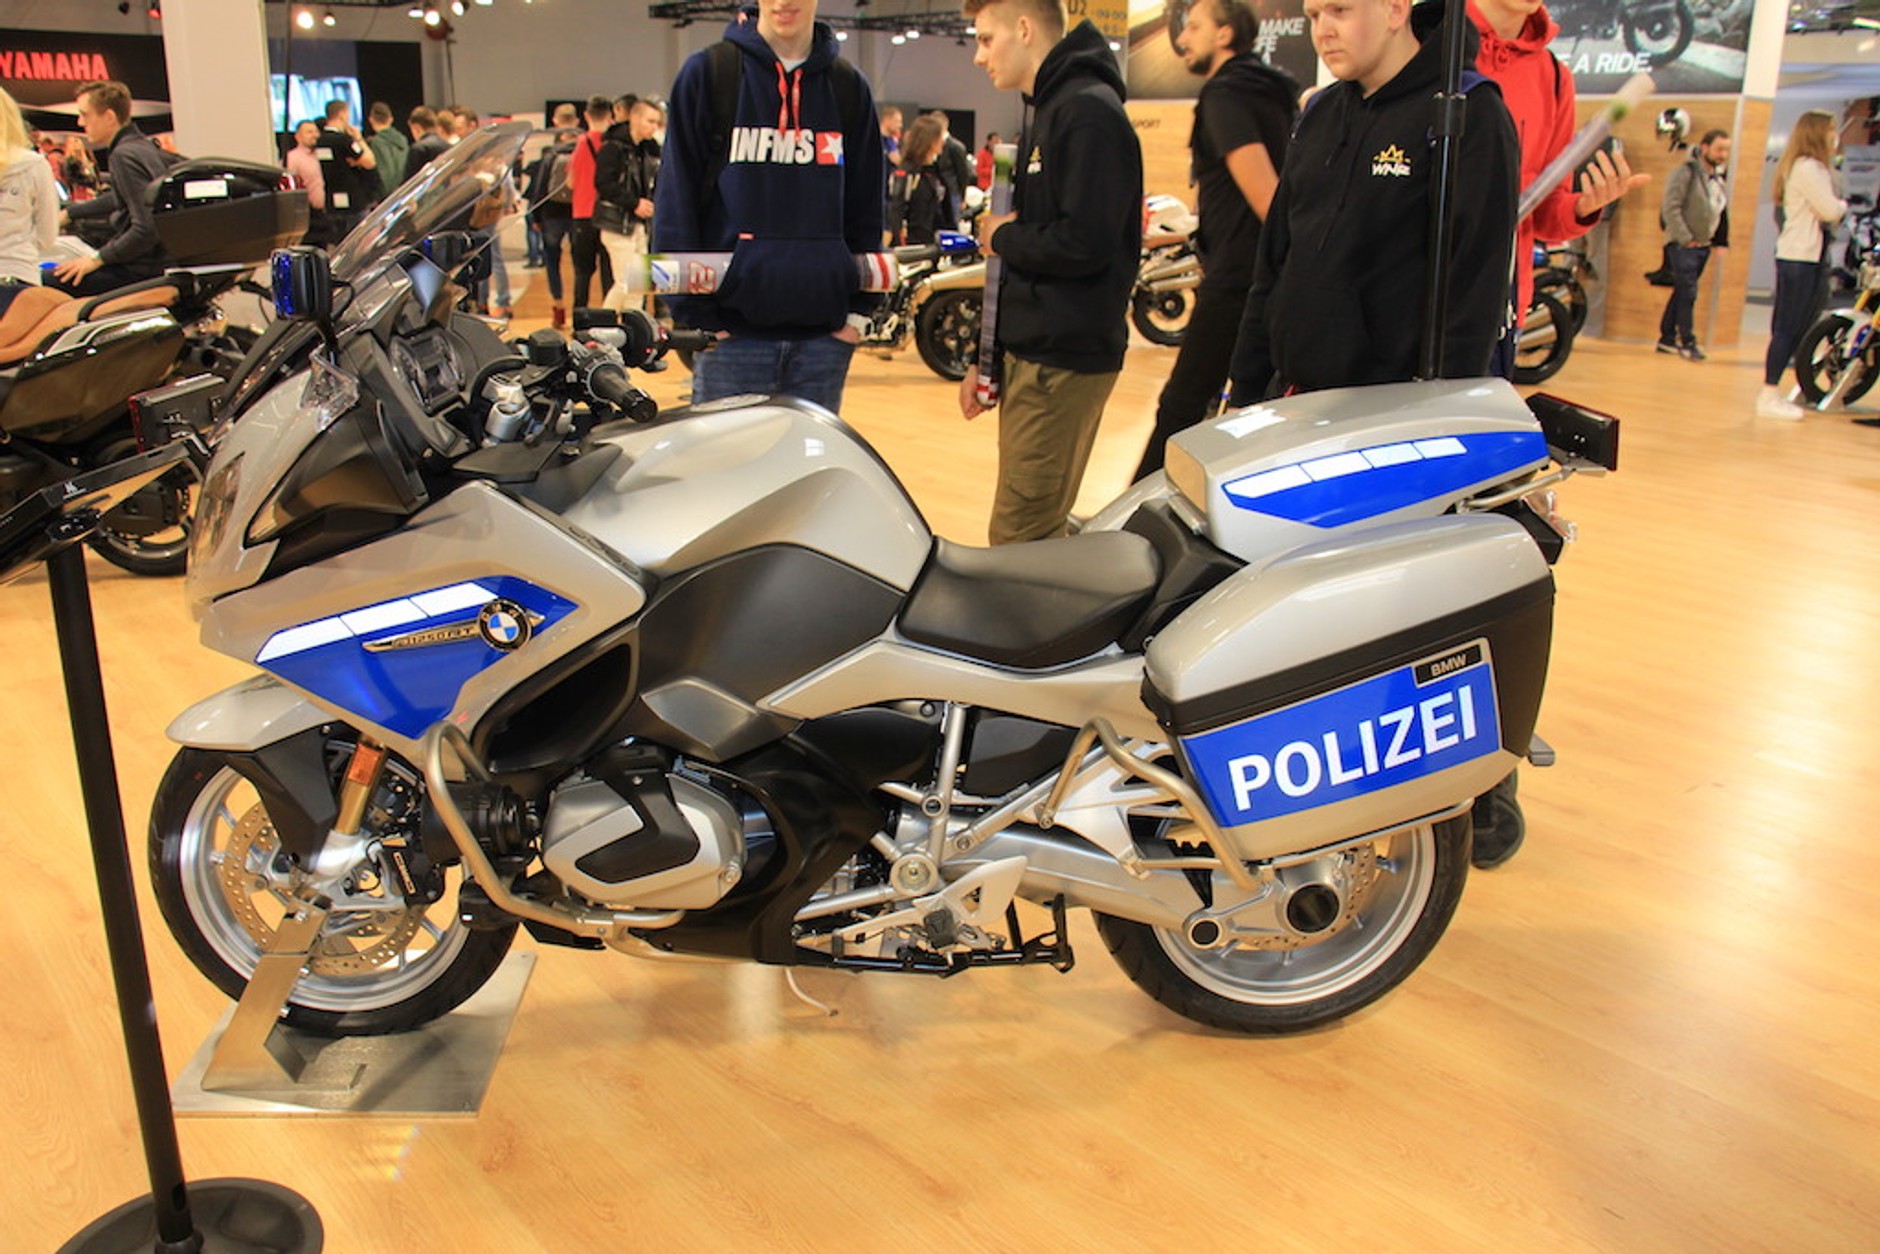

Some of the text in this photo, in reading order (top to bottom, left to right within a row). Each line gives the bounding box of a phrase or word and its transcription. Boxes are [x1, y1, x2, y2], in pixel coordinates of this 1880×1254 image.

[1258, 17, 1305, 37] MAKE
[0, 51, 110, 80] YAMAHA
[1572, 53, 1589, 74] A
[1595, 52, 1653, 74] RIDE.
[729, 127, 815, 165] INFMS
[1430, 653, 1467, 677] BMW
[1227, 684, 1478, 812] POLIZEI
